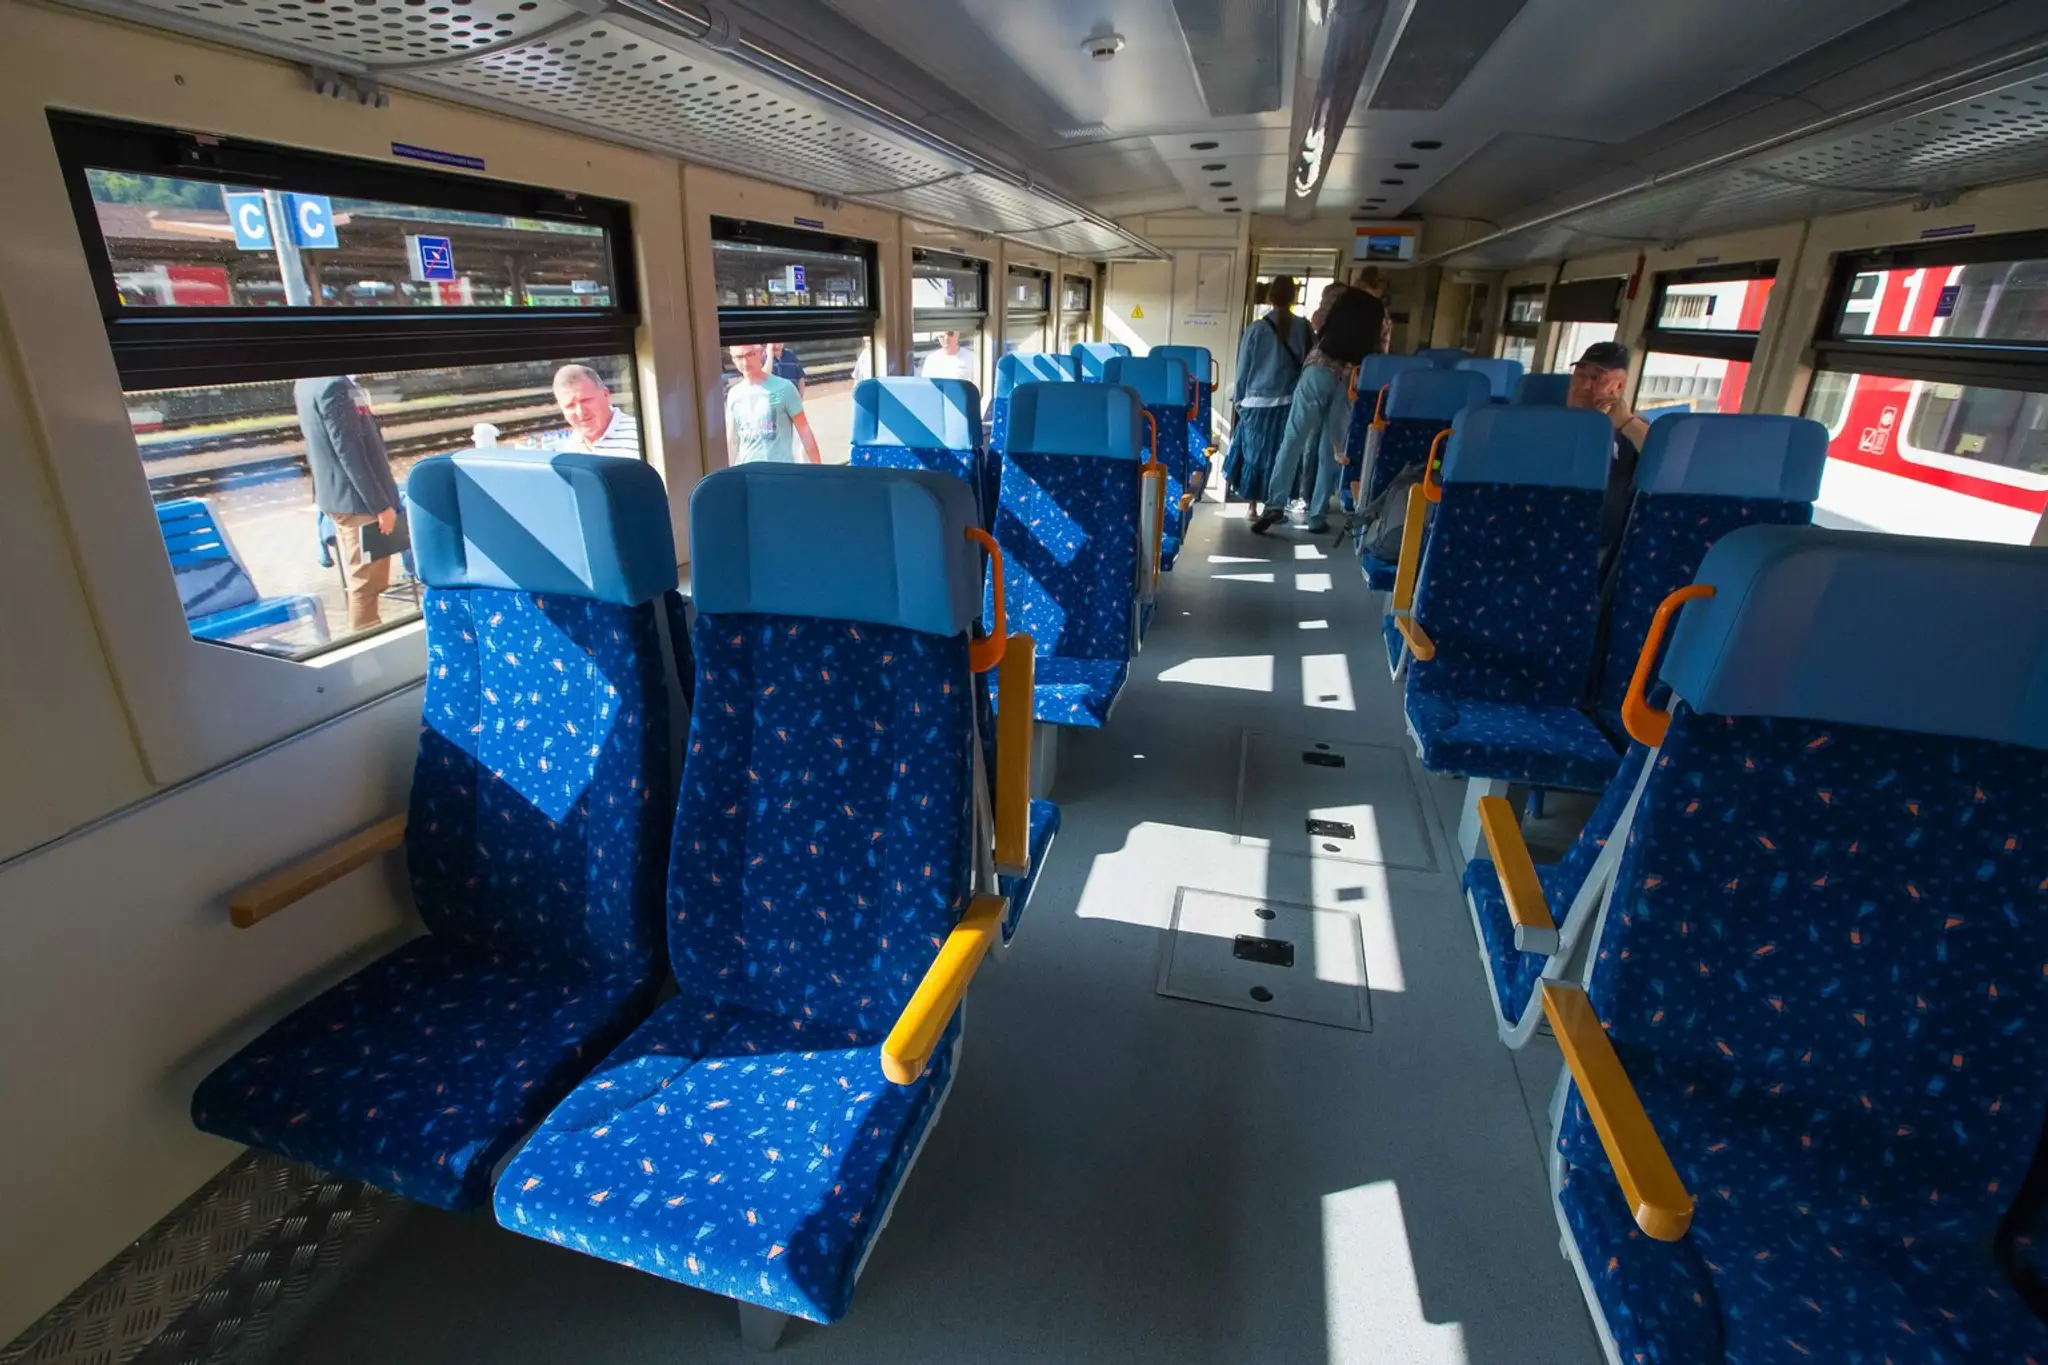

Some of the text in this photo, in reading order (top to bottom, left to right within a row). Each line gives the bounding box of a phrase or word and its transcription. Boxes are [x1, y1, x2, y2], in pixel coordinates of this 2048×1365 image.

[239, 203, 264, 239] C
[300, 201, 325, 238] C
[1898, 268, 1926, 332] 1
